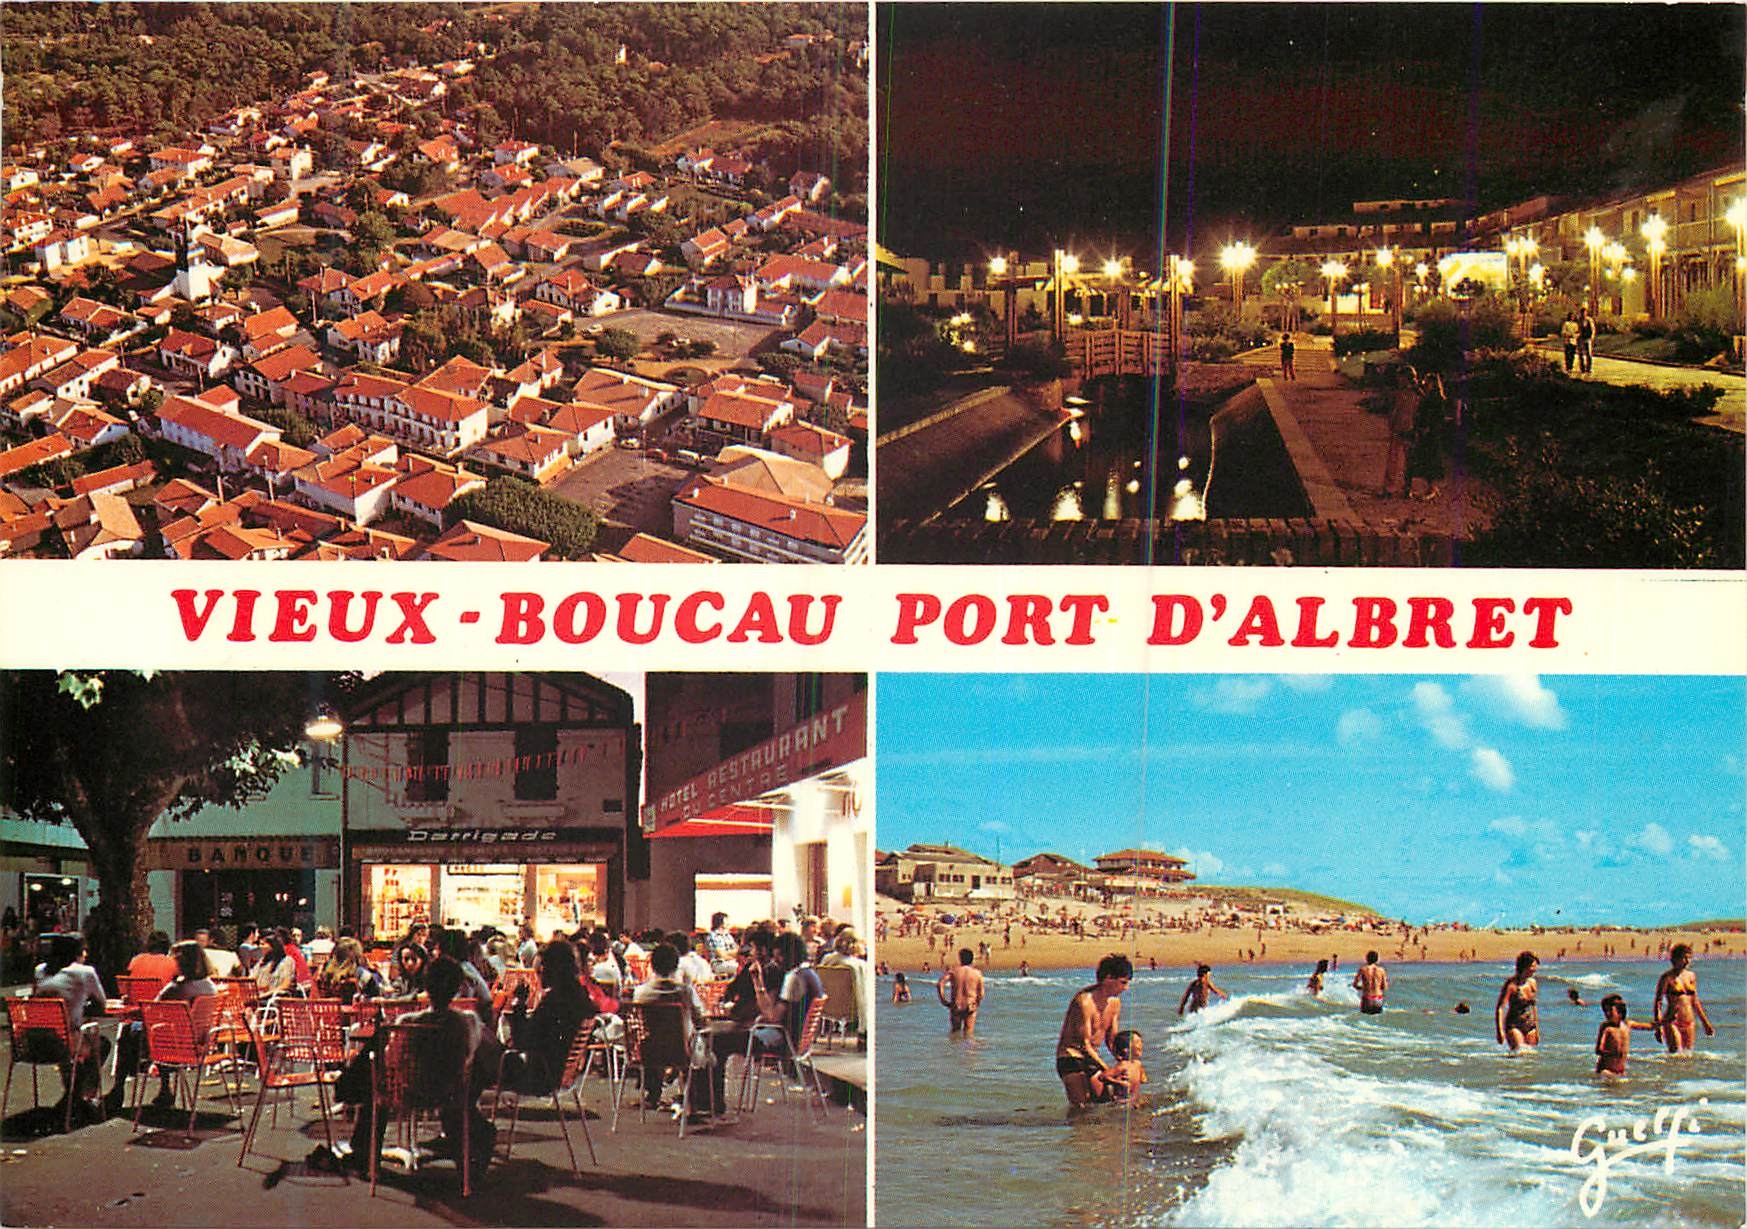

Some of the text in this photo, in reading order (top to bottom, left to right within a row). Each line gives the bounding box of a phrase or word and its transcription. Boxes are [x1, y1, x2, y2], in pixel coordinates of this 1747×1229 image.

[661, 705, 849, 812] HOTEL RESTAURANT
[708, 763, 789, 808] CENTRE
[407, 829, 557, 843] Darrigade
[188, 846, 314, 863] BANQUE
